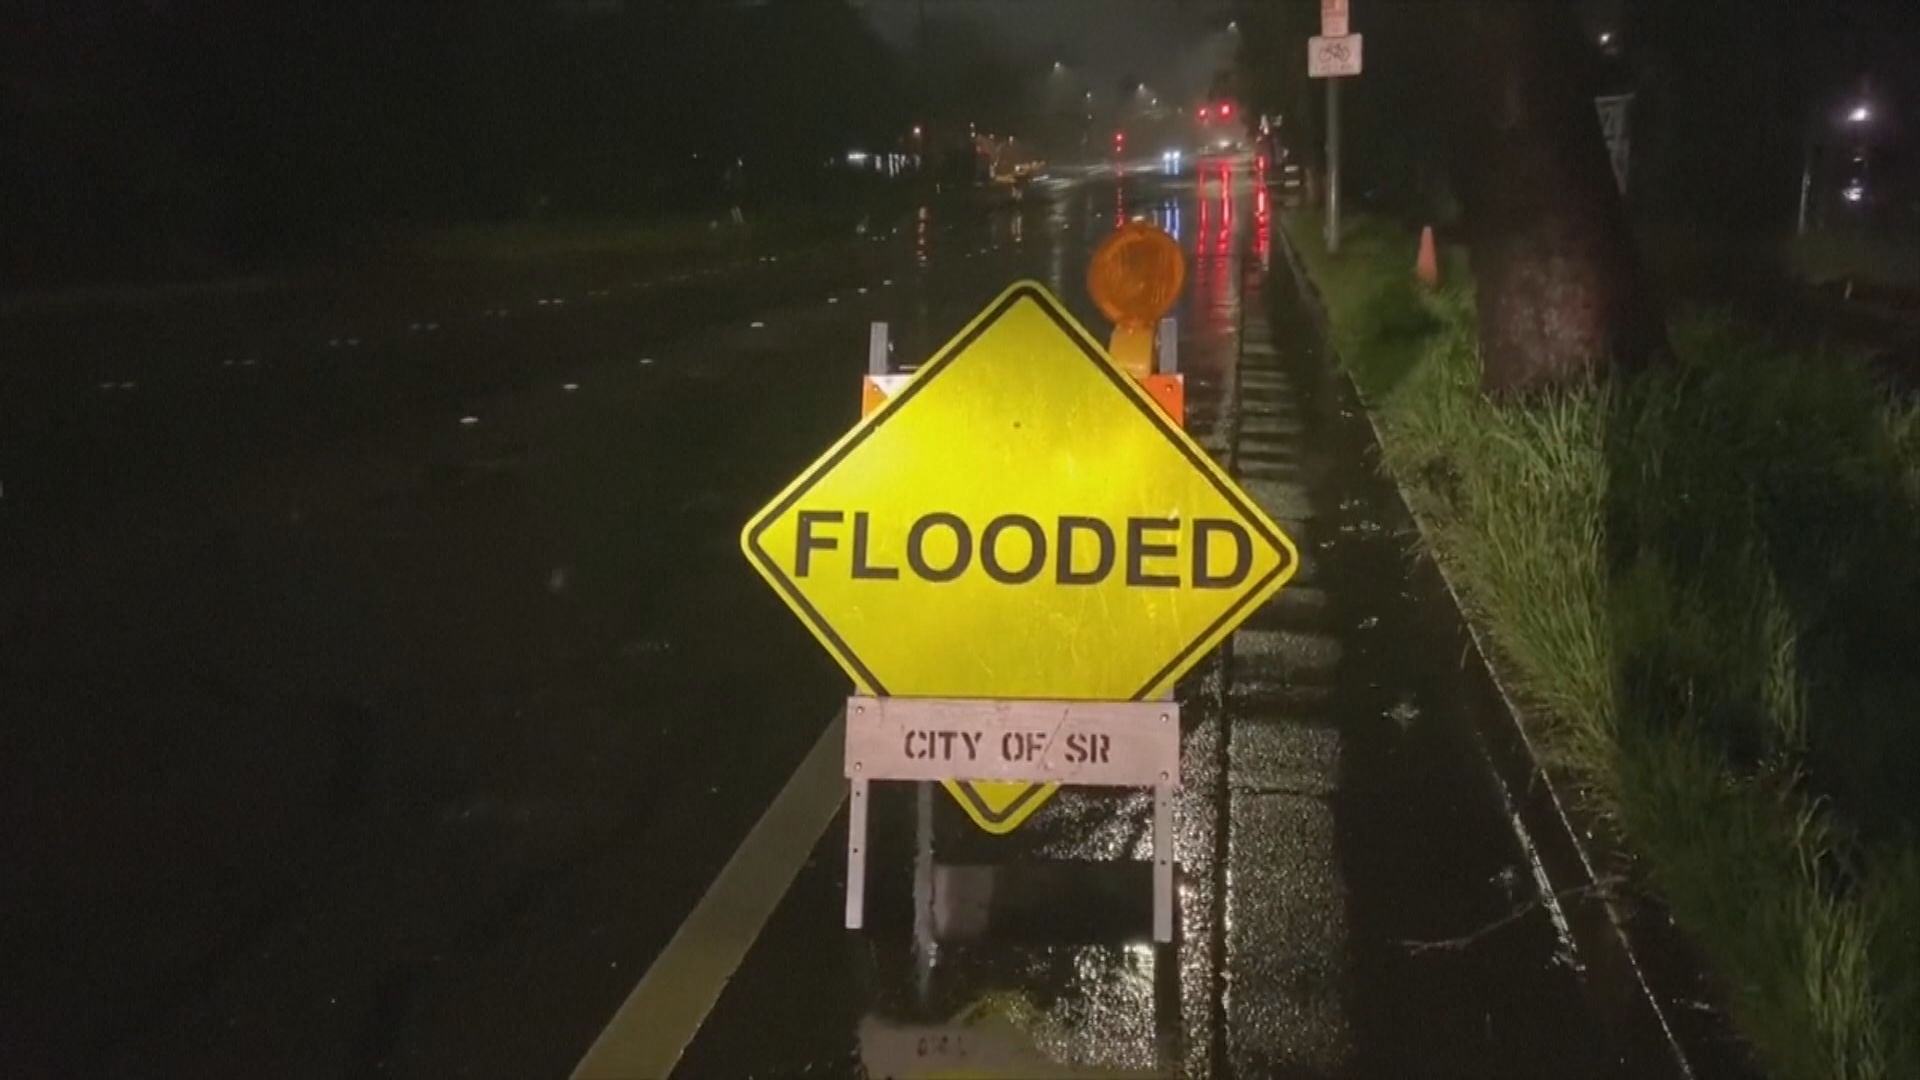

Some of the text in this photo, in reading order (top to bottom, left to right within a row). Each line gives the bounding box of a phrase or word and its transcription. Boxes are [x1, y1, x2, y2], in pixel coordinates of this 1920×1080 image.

[794, 510, 1254, 590] FLOODED
[904, 730, 1111, 764] CITY OF SR
